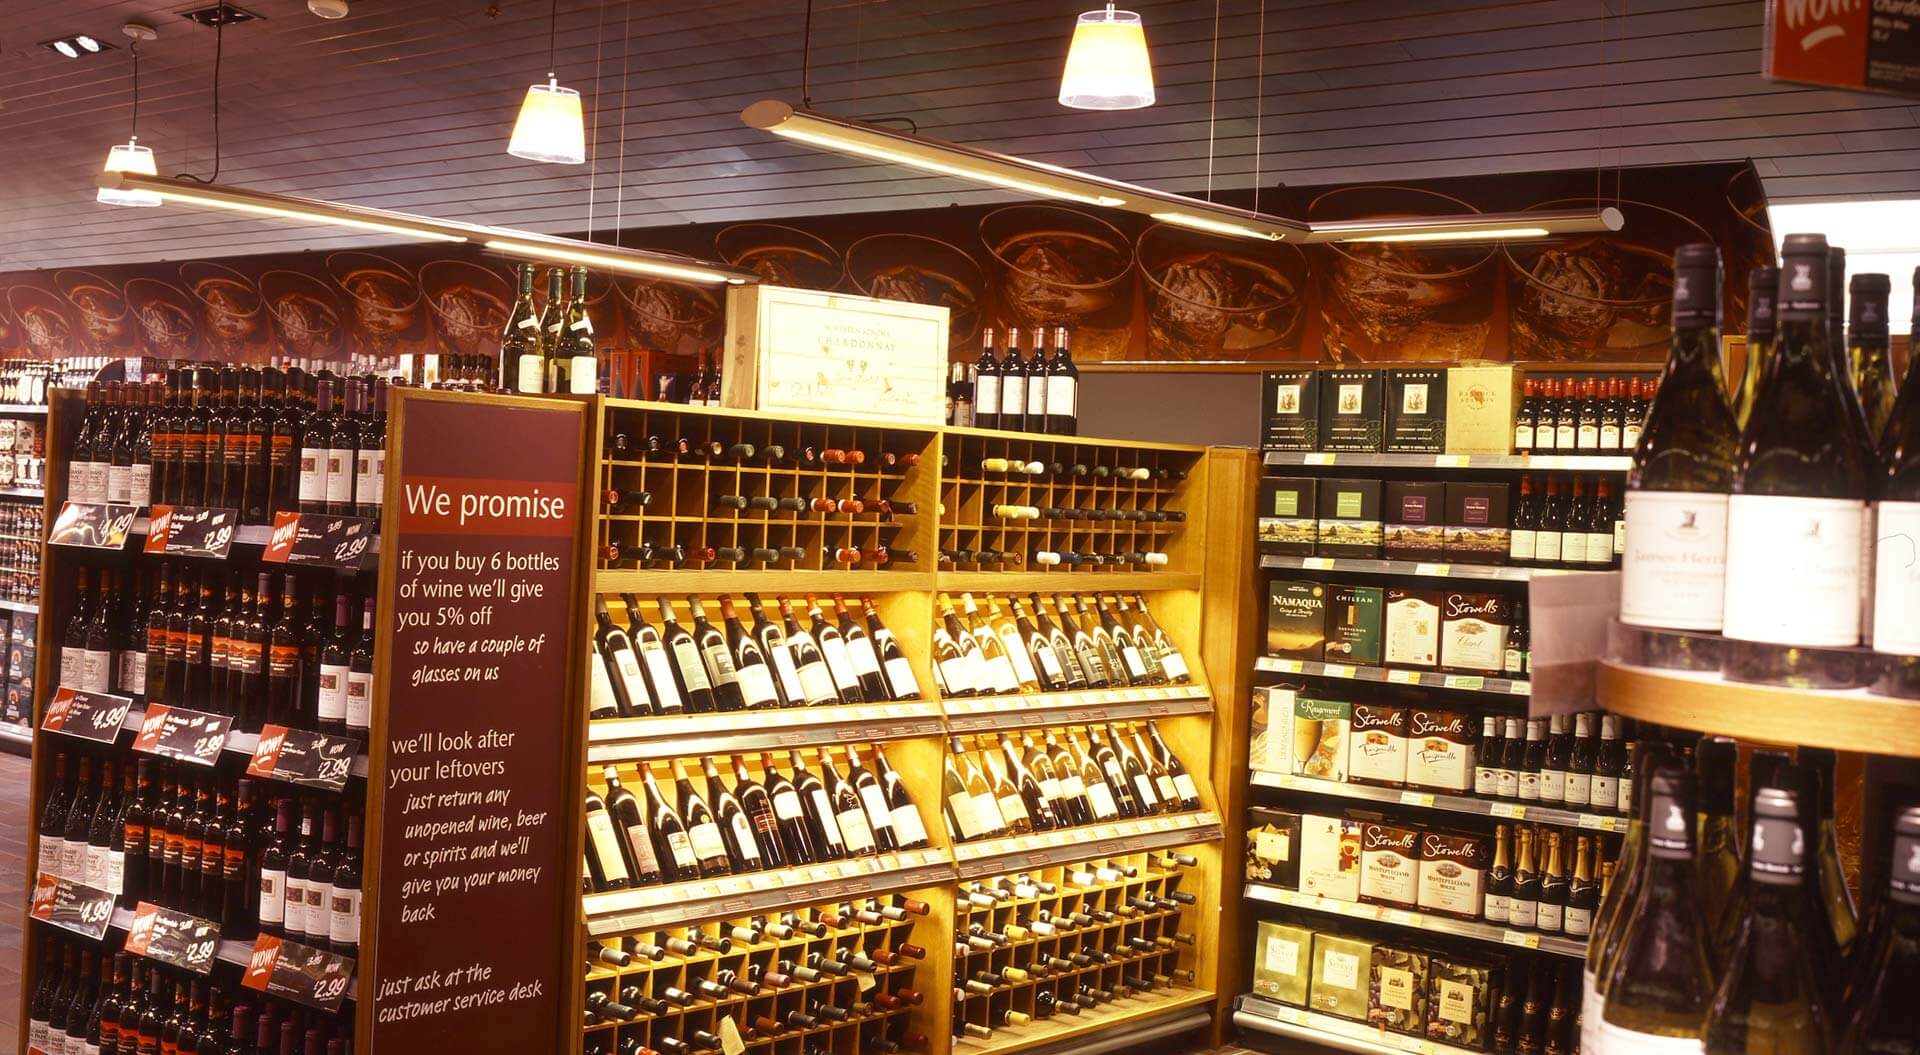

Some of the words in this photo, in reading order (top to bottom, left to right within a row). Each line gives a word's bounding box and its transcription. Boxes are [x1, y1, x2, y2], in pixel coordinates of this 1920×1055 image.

[405, 484, 451, 516] We
[460, 489, 565, 526] promise
[150, 511, 172, 536] WOW!
[272, 519, 298, 545] WOW!
[204, 525, 232, 550] £2.99
[334, 536, 368, 560] £2.99
[401, 550, 414, 570] if
[416, 553, 449, 575] you
[455, 551, 486, 576] buy
[491, 551, 501, 571] 6
[506, 552, 560, 571] bottles
[400, 578, 418, 598] of
[423, 580, 463, 598] wine
[468, 579, 506, 598] we'll
[510, 581, 544, 603] give
[1272, 595, 1323, 609] NAMAQUA
[1336, 595, 1373, 603] CHILEAN
[1446, 594, 1498, 617] Stowells
[397, 610, 430, 632] you
[436, 607, 465, 626] 5%
[469, 605, 493, 626] off
[413, 640, 430, 656] so
[433, 636, 466, 655] have
[468, 639, 477, 654] a
[480, 634, 525, 658] couple
[528, 634, 546, 655] of
[411, 665, 460, 687] glasses
[464, 667, 481, 682] on
[484, 665, 500, 682] us
[91, 706, 126, 730] £4.99
[1353, 706, 1402, 728] Stowells
[1411, 712, 1464, 735] Stowells
[194, 734, 225, 756] £2.99
[256, 733, 284, 757] WOW!
[392, 733, 432, 754] we'll
[438, 731, 473, 752] look
[478, 729, 515, 749] after
[317, 757, 351, 780] £2.99
[389, 765, 431, 789] your
[435, 759, 505, 781] leftovers
[402, 792, 436, 814] just
[437, 791, 482, 808] return
[485, 788, 511, 806] any
[405, 815, 475, 841] unopened
[478, 815, 513, 833] wine,
[516, 809, 547, 828] beer
[1365, 825, 1414, 848] Stowells
[404, 851, 421, 868] or
[422, 846, 467, 870] spirits
[470, 840, 498, 861] and
[500, 836, 530, 857] we'll
[1424, 835, 1475, 858] Stowells
[401, 877, 431, 899] give
[435, 875, 460, 897] you
[464, 869, 495, 893] your
[497, 865, 541, 885] money
[79, 900, 112, 922] £4.99
[401, 904, 436, 923] back
[186, 940, 215, 961] £2.99
[251, 945, 279, 969] WOW!
[313, 978, 346, 999] £2.99
[376, 977, 412, 1001] just
[414, 970, 441, 993] ask
[444, 967, 464, 987] at
[466, 962, 492, 984] the
[378, 998, 451, 1024] customer
[453, 987, 506, 1012] service
[508, 979, 543, 1001] desk
